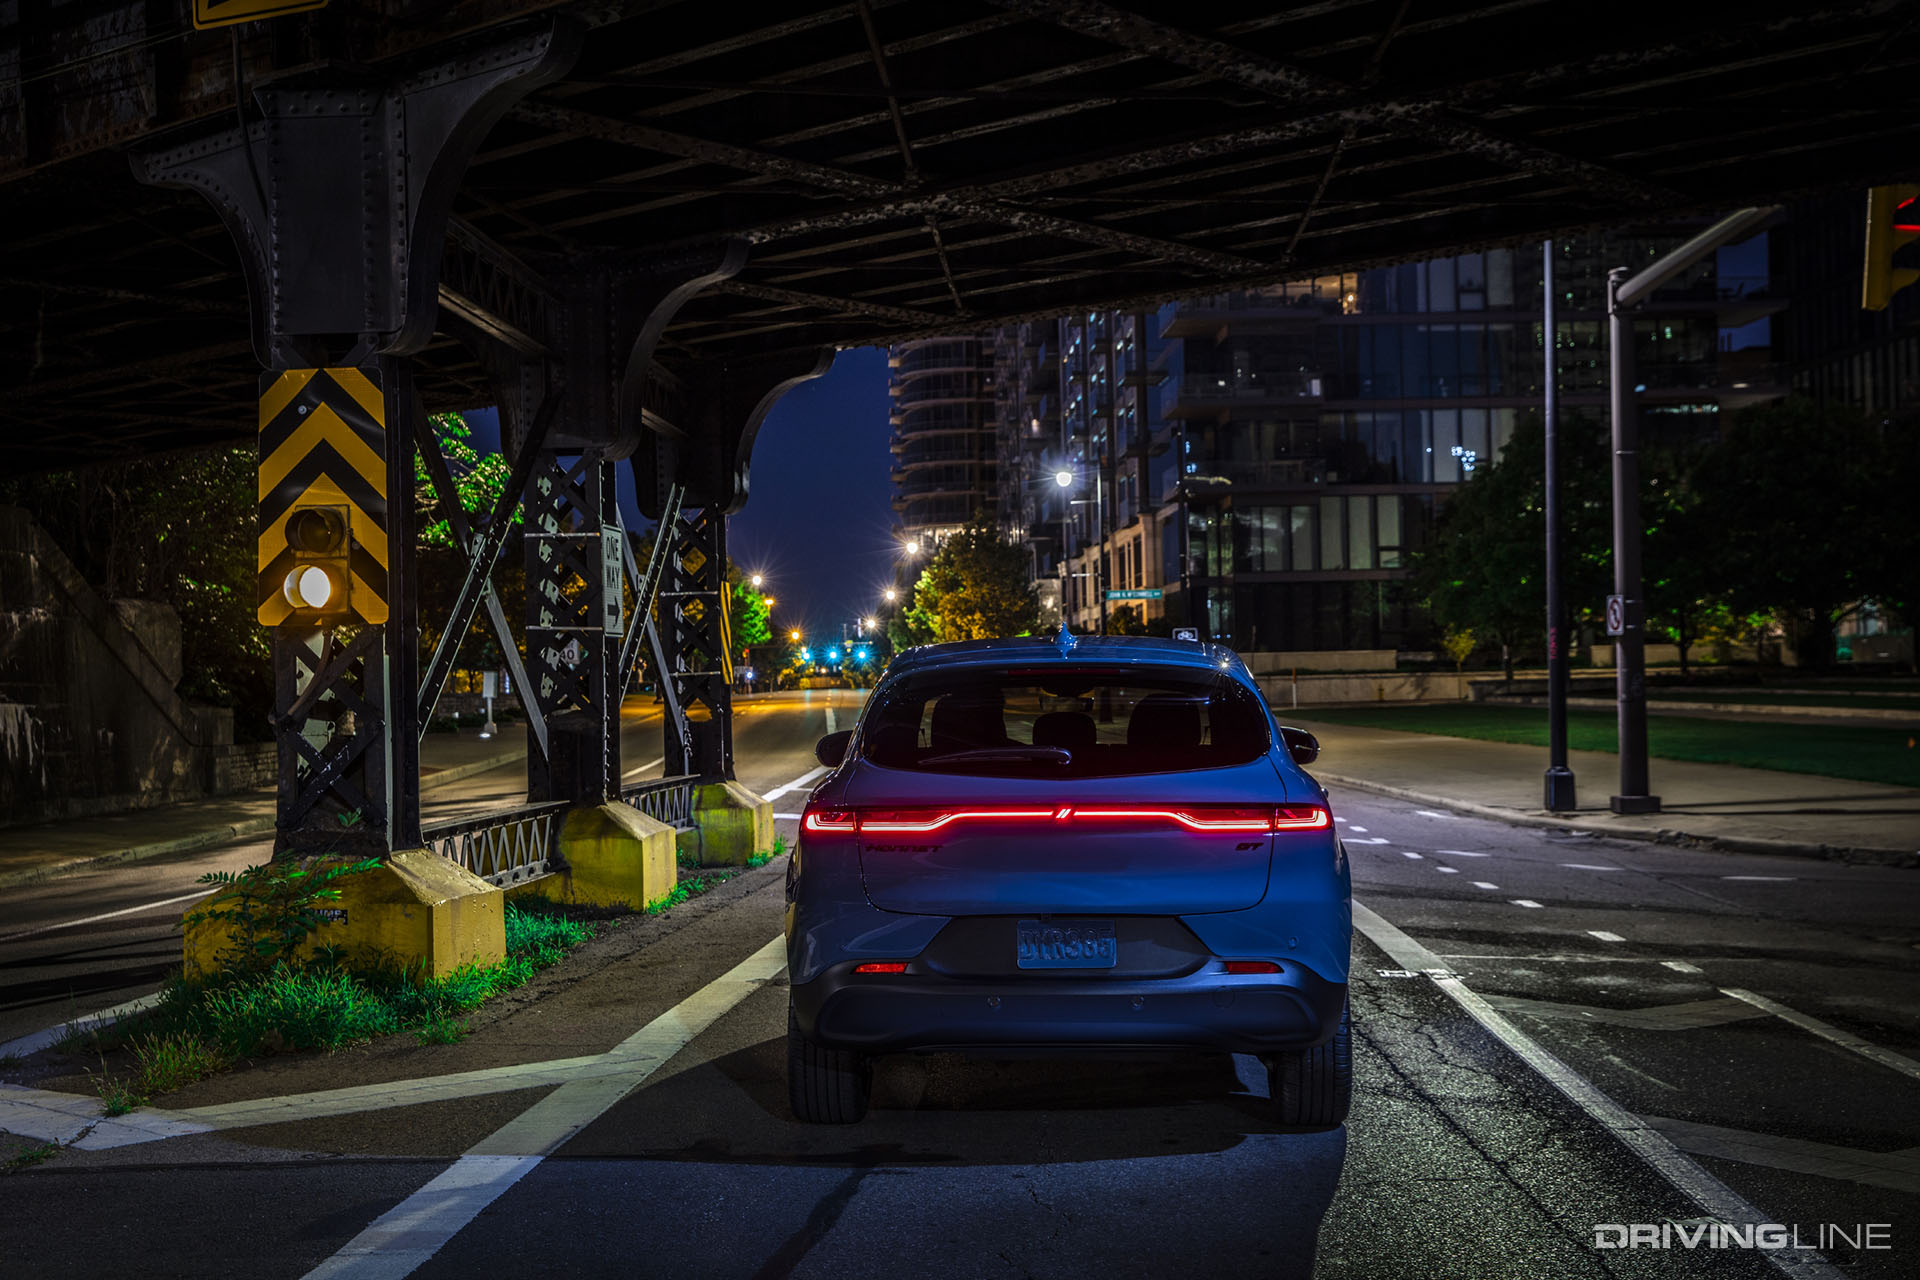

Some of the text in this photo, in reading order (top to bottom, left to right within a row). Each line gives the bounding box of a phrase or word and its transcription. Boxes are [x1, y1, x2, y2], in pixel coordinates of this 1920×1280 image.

[605, 535, 619, 561] ONE
[606, 564, 620, 589] WAY
[1235, 842, 1264, 851] GT
